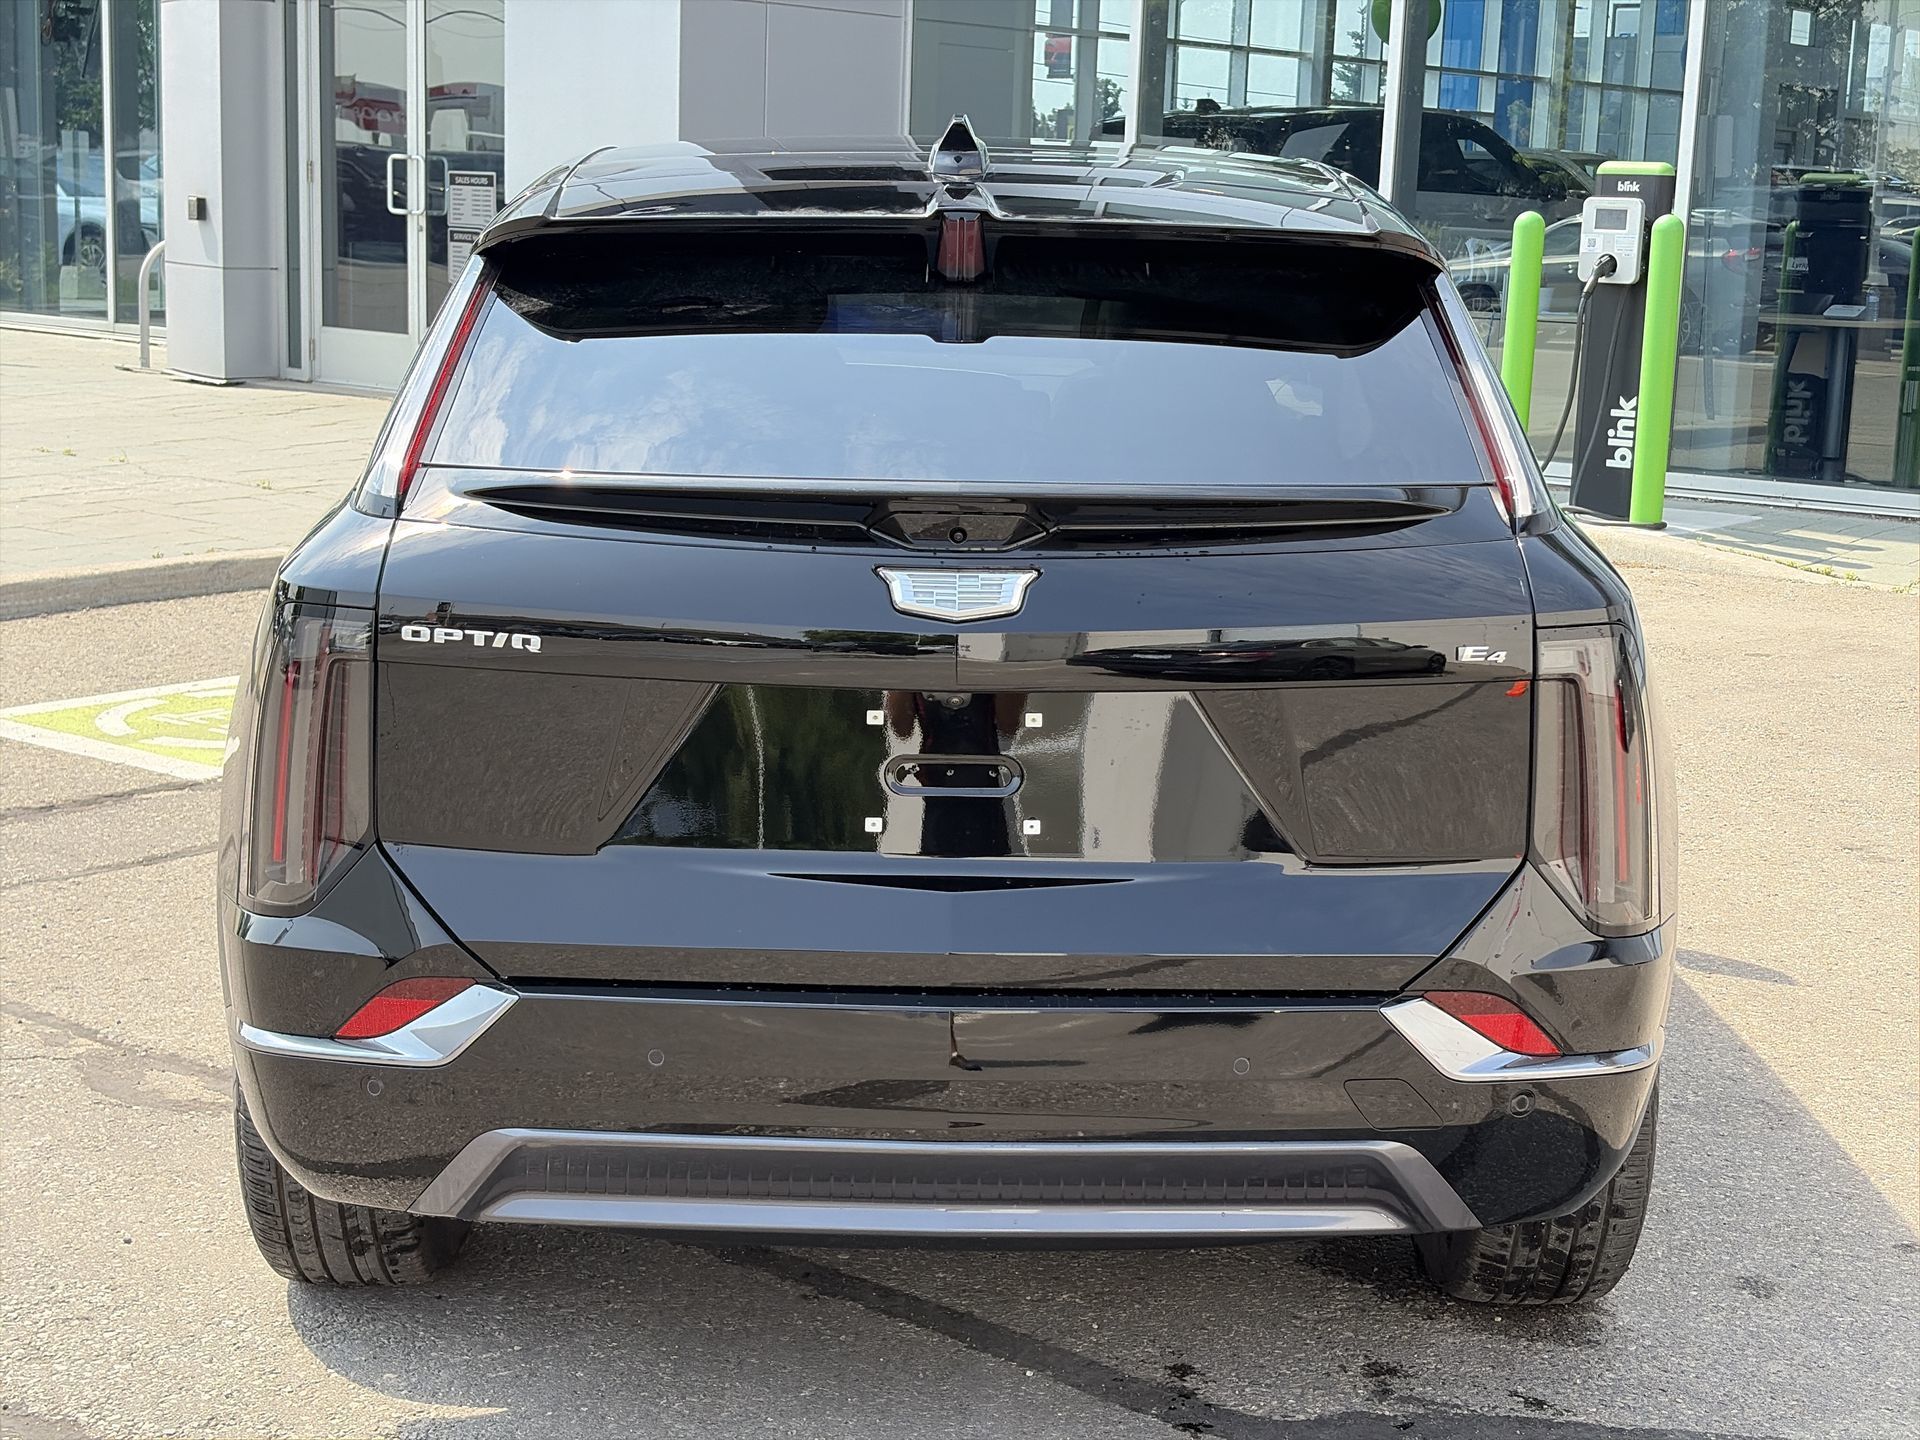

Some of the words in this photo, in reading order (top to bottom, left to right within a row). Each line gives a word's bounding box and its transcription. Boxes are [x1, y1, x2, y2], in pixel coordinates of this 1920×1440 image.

[455, 176, 470, 184] SALES
[471, 177, 489, 185] HOURS
[1617, 181, 1640, 192] blink
[1606, 395, 1638, 469] blink
[401, 625, 542, 653] OPTIQ
[1459, 646, 1508, 663] E4
